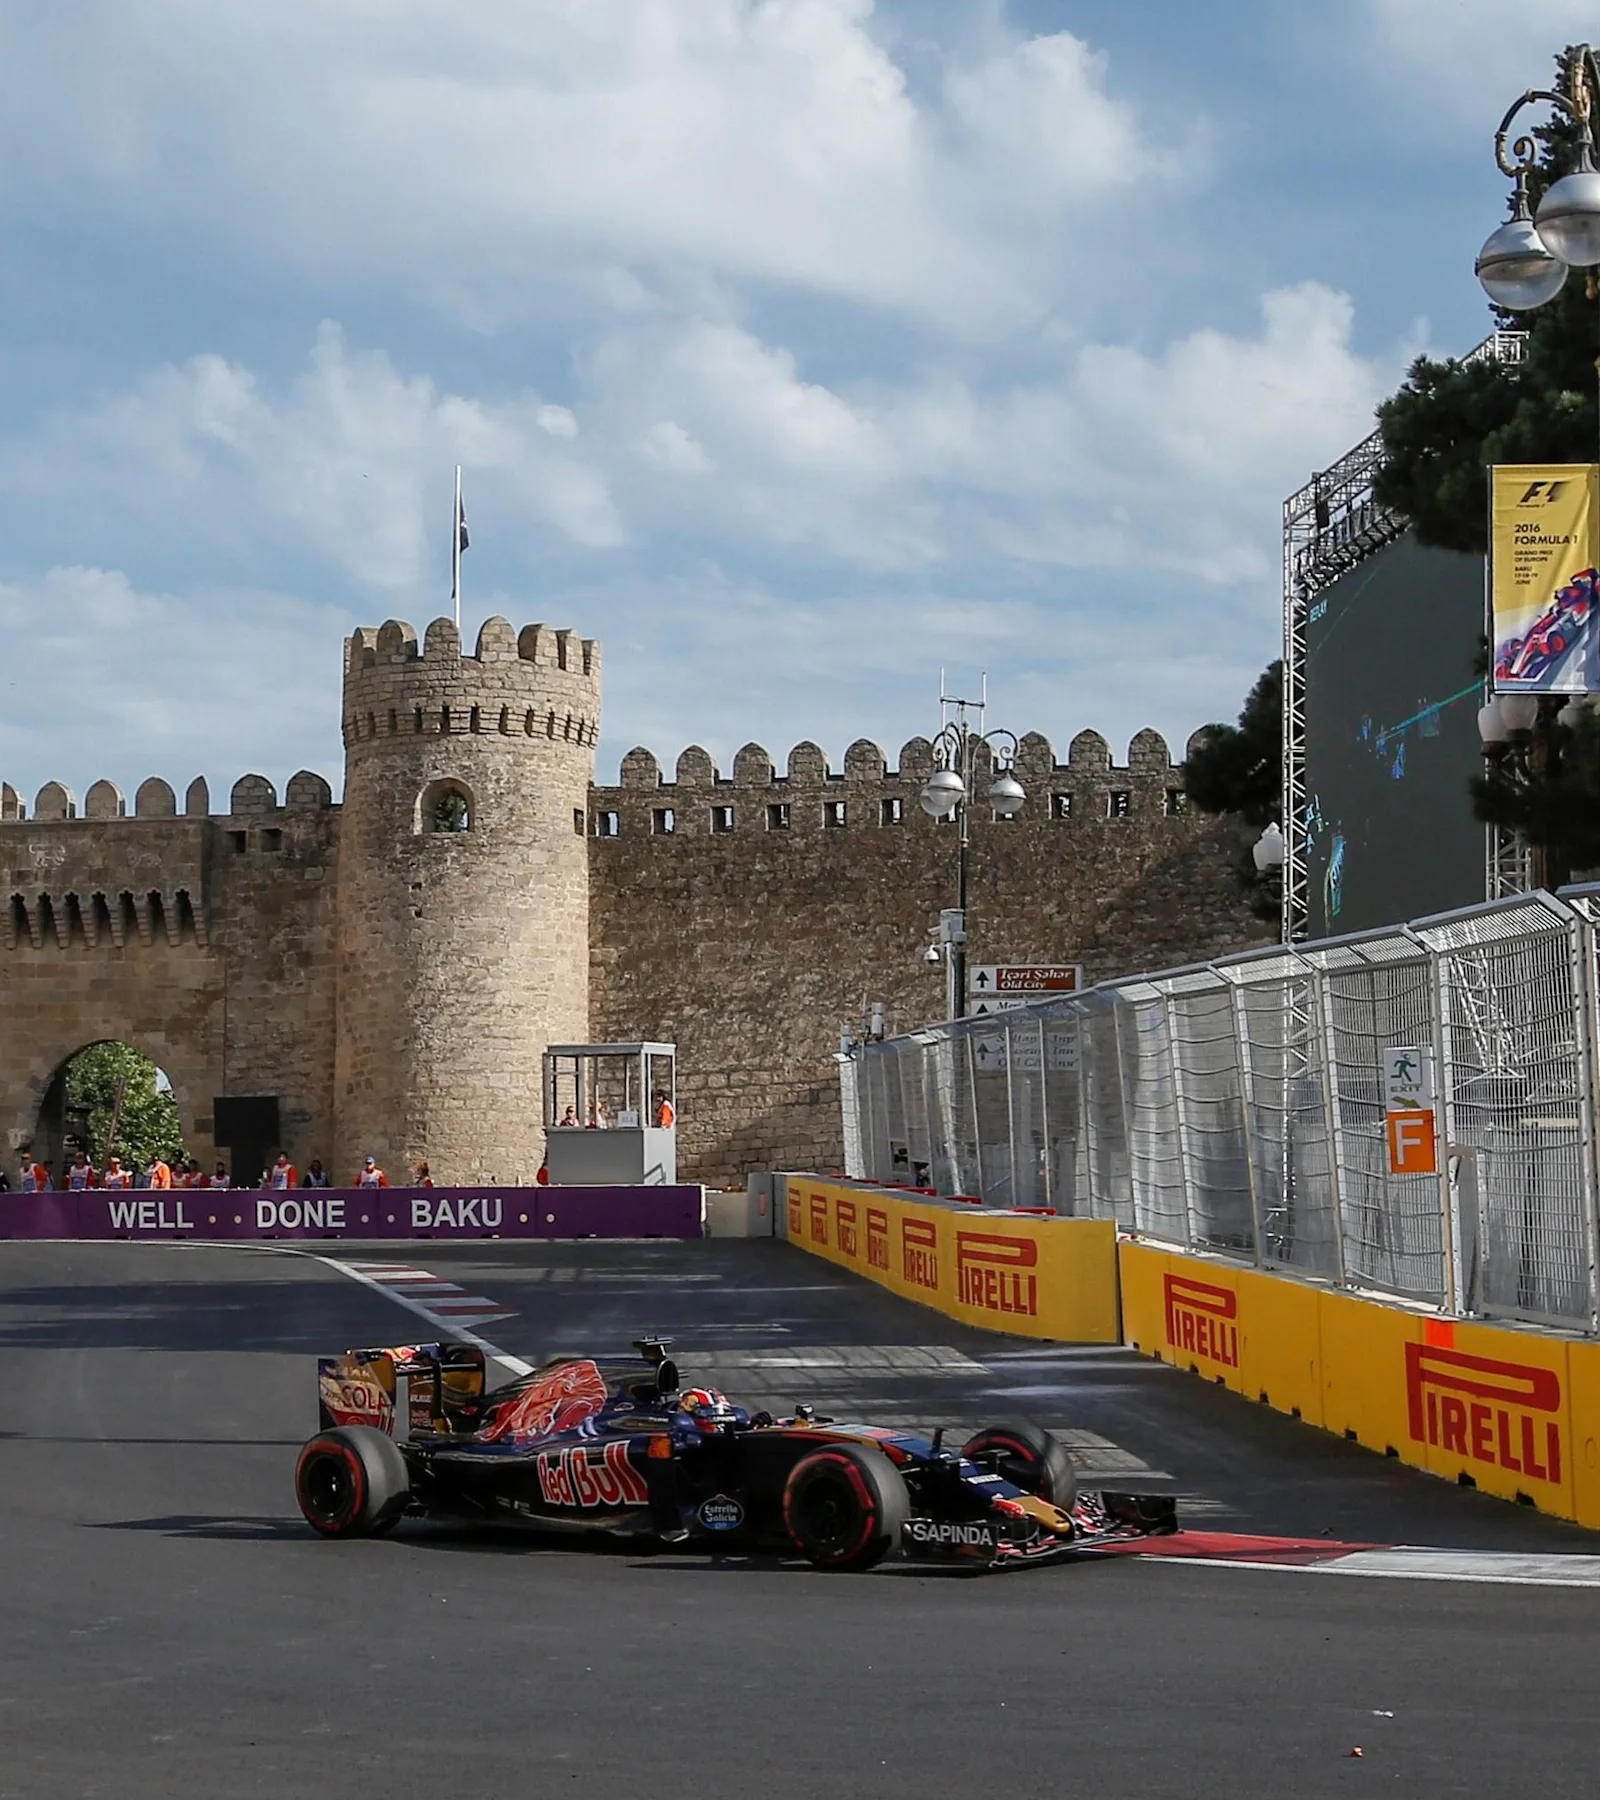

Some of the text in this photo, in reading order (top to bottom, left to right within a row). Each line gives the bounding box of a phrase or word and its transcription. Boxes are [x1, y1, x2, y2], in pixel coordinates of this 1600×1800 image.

[1520, 481, 1570, 503] F1
[1514, 524, 1540, 533] 2016
[1514, 535, 1578, 545] FORMULA 1
[1001, 980, 1046, 990] Old City
[1390, 1084, 1420, 1092] EXIT
[1395, 1118, 1424, 1165] F
[107, 1200, 194, 1229] WELL
[255, 1199, 346, 1229] DONE
[410, 1198, 503, 1228] BAKU
[902, 1217, 938, 1291] PIRELLI
[956, 1230, 1038, 1316] PIRELLI
[1163, 1273, 1239, 1368] PIRELLI
[1404, 1341, 1561, 1484] PIRELLI
[537, 1440, 649, 1507] Red Bull
[912, 1522, 993, 1546] SAPINDA
